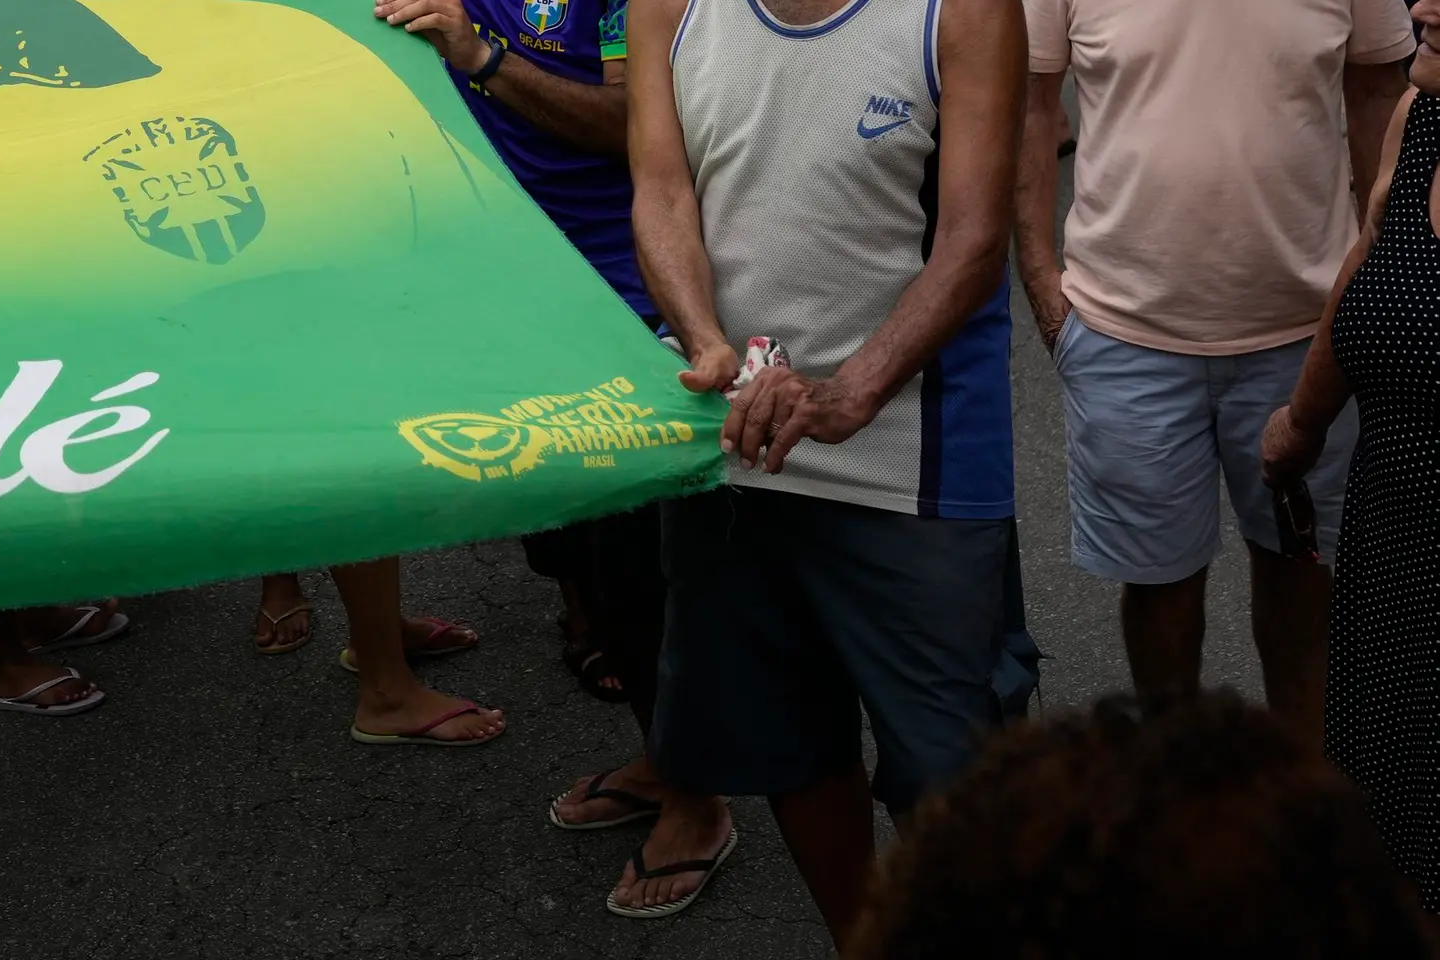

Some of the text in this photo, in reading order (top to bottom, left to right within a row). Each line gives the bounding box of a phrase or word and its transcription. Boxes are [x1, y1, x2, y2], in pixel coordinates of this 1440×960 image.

[519, 33, 564, 52] BRASIL
[864, 95, 915, 118] NIKE
[583, 454, 616, 469] BRASIL
